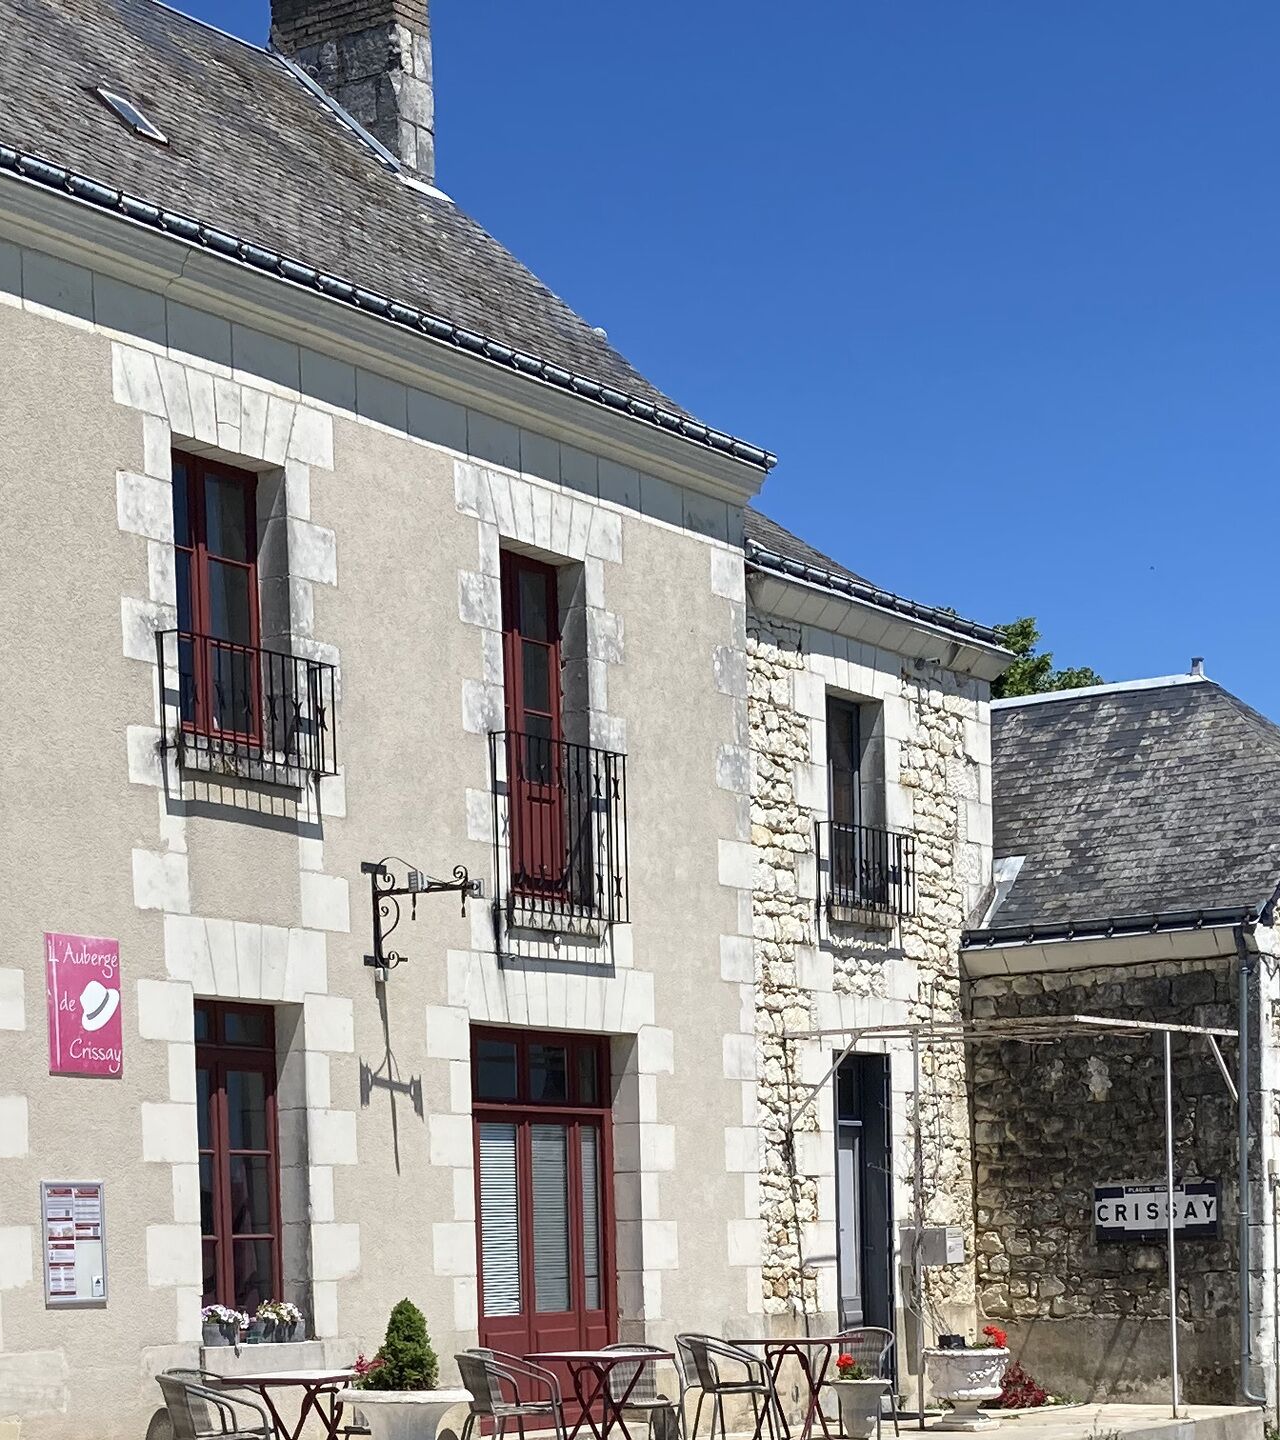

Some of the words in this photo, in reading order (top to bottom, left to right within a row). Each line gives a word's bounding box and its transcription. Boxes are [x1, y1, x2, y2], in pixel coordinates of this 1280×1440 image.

[48, 940, 118, 979] L'Auberge
[59, 991, 77, 1012] de
[70, 1038, 122, 1074] Crissay
[1097, 1200, 1214, 1222] CRISSAY
